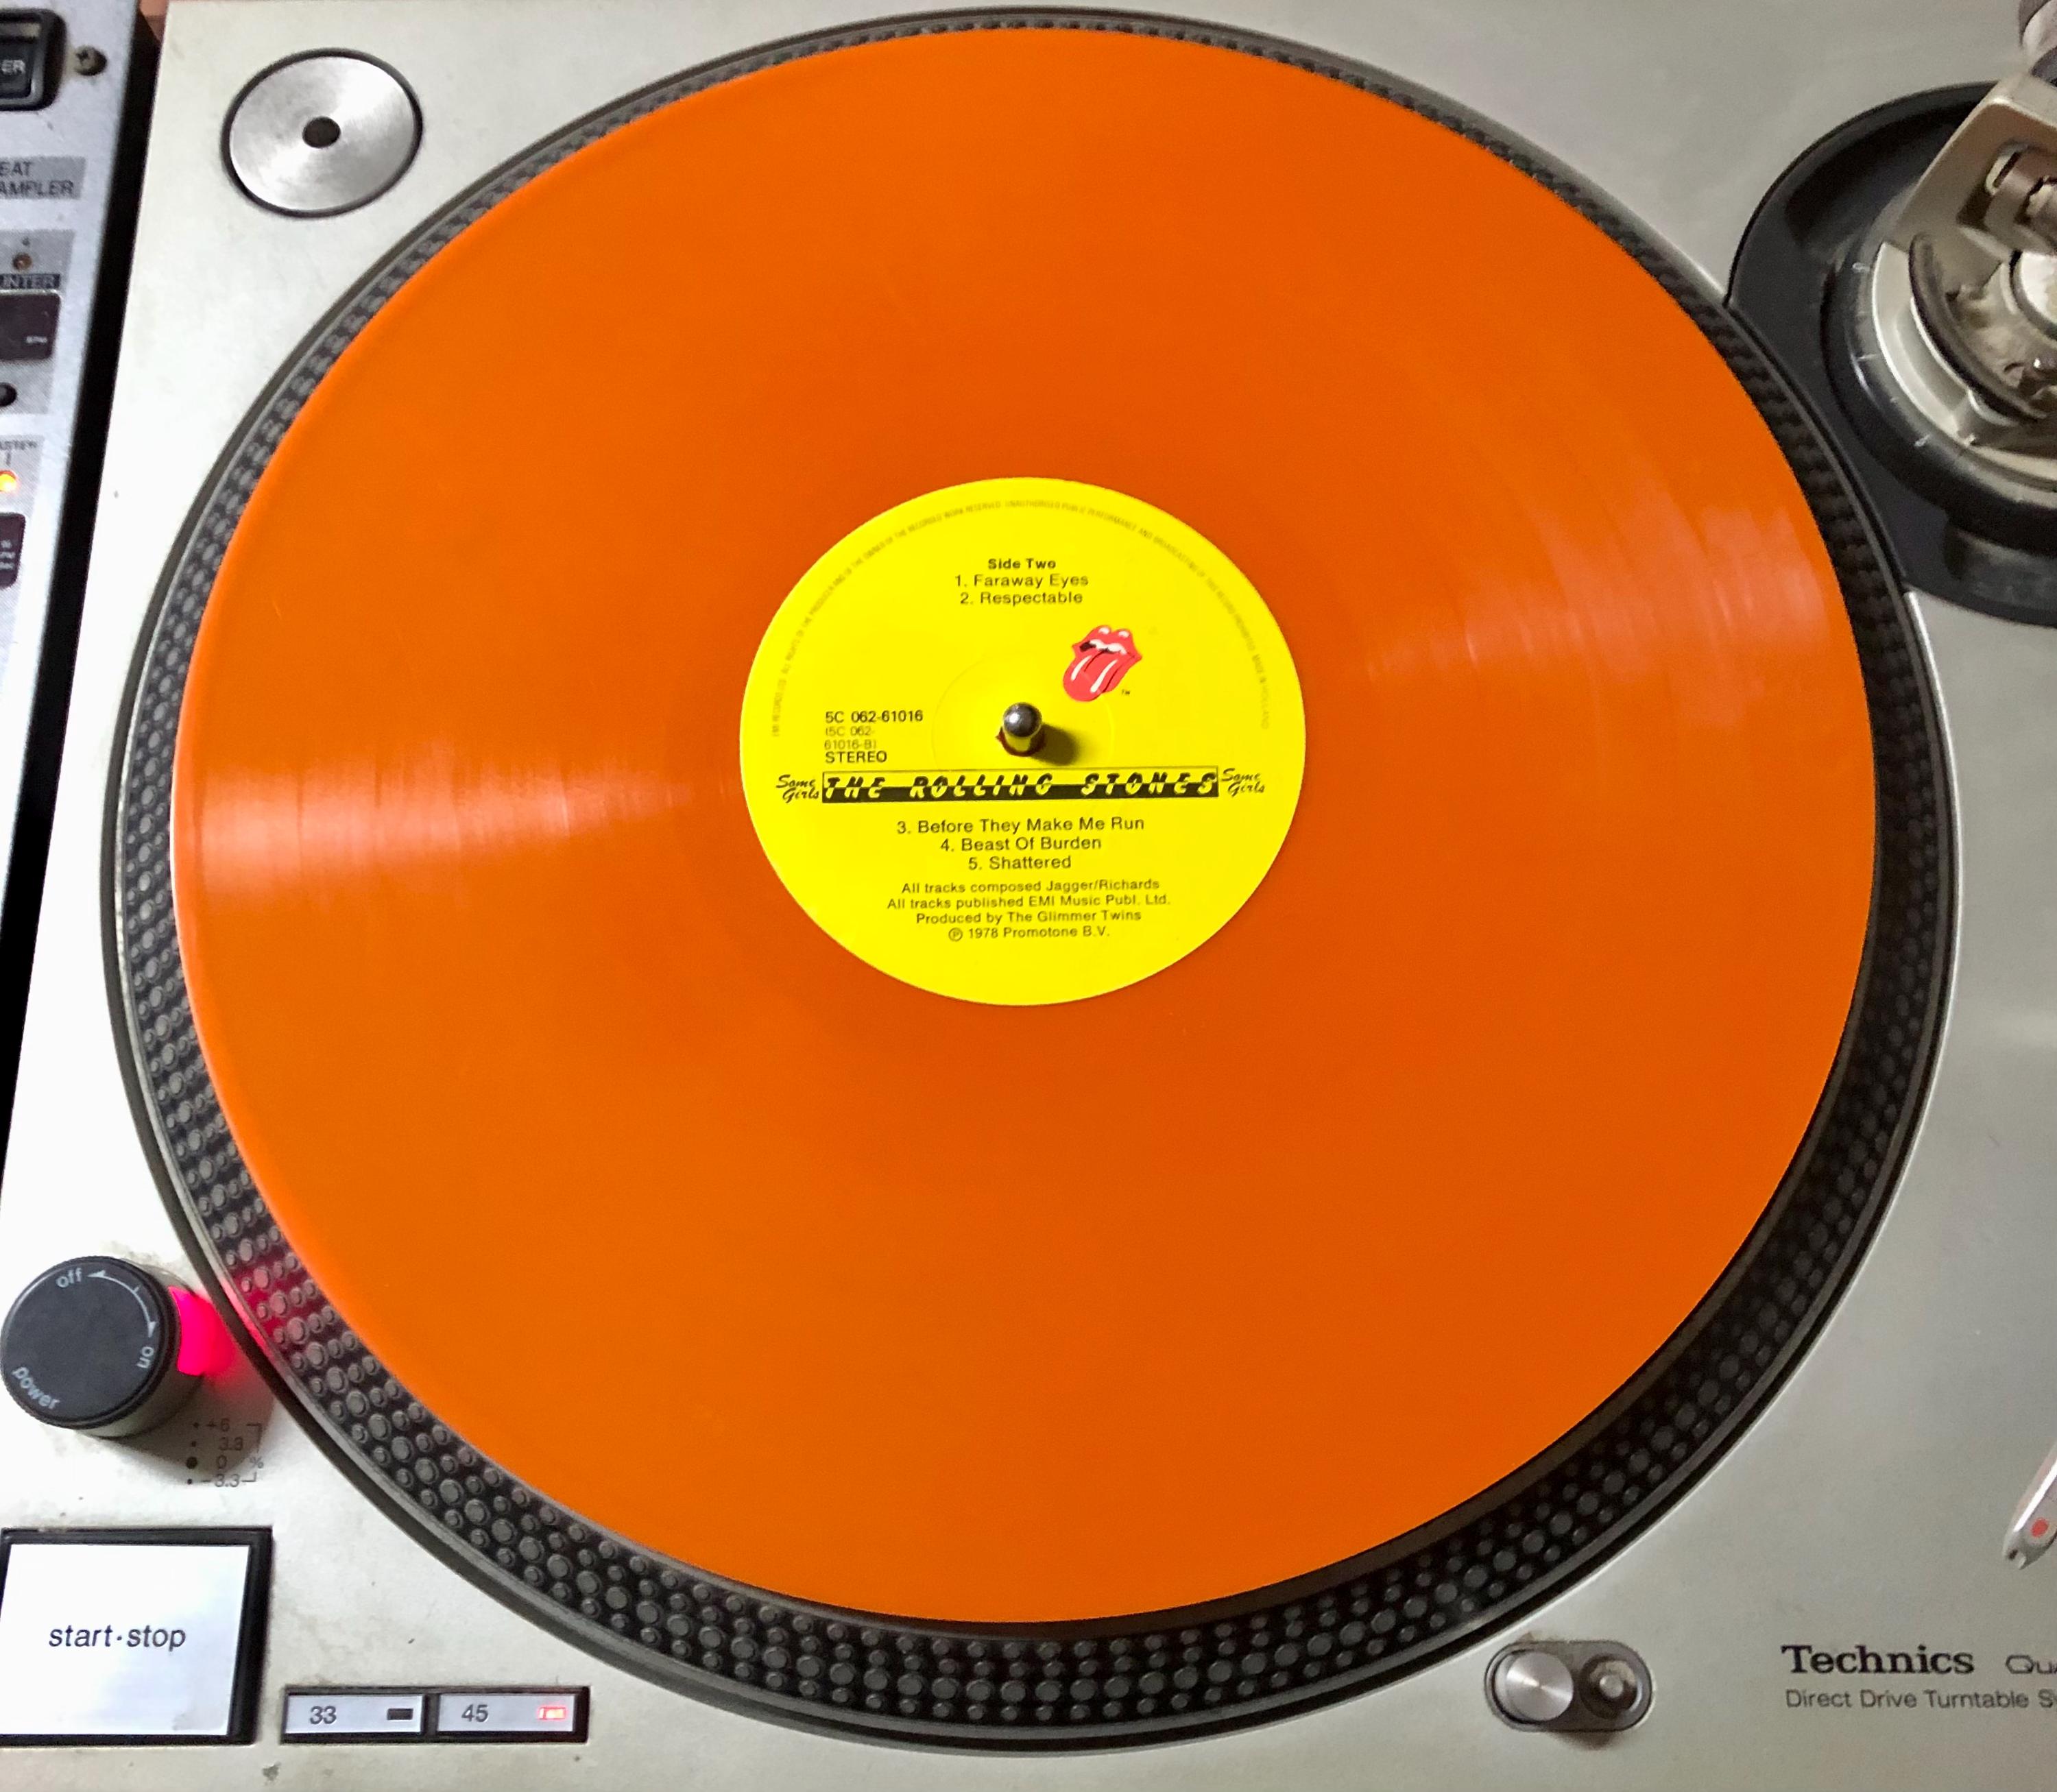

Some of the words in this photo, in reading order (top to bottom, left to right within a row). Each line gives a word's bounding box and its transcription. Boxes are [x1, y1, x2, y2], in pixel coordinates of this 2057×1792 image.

[988, 558, 1021, 570] Side
[1026, 558, 1056, 569] Two
[955, 574, 967, 587] 1.
[974, 574, 1043, 589] Faraway
[1050, 573, 1089, 589] Eyes
[960, 592, 973, 605] 2.
[981, 591, 1083, 607] Respectable
[826, 711, 844, 724] 5C
[851, 710, 923, 723] 062-61016
[825, 751, 888, 764] STEREO
[775, 774, 816, 789] Some
[1221, 767, 1262, 783] Some
[825, 776, 886, 799] THE
[909, 773, 1053, 799] ROLLING
[1081, 772, 1218, 796] STONES
[1228, 782, 1266, 797] Girls
[782, 788, 819, 803] Girls
[897, 821, 911, 834] 3.
[918, 820, 973, 834] Before
[979, 819, 1020, 835] They
[1027, 818, 1073, 832] Make
[1079, 817, 1105, 830] Me
[1111, 816, 1144, 830] Run
[940, 838, 954, 851] 4.
[961, 838, 1009, 851] Beast
[1015, 836, 1035, 851] Of
[1041, 836, 1101, 850] Burden
[969, 857, 982, 871] 5.
[989, 855, 1071, 870] Shattered
[902, 882, 919, 893] All
[924, 882, 965, 893] tracks
[970, 880, 1041, 895] composed
[1046, 878, 1159, 894] Jagger/Richards
[887, 899, 905, 909] All
[911, 897, 951, 909] tracks
[956, 896, 1023, 912] published
[1029, 895, 1055, 907] EMI
[1060, 893, 1100, 906] Music
[1105, 894, 1140, 906] Publ.
[1145, 894, 1170, 905] Ltd.
[917, 912, 981, 924] Produced
[986, 912, 1002, 925] by
[1007, 911, 1033, 923] The
[1037, 910, 1097, 922] Glimmer
[1100, 910, 1141, 921] Twins
[969, 928, 998, 939] 1978
[1003, 927, 1078, 938] Promotone
[1083, 925, 1109, 937] B.V.
[56, 1267, 82, 1288] off
[138, 1345, 155, 1369] on
[12, 1366, 60, 1410] power
[1780, 1644, 1975, 1675] Technics
[1786, 1688, 1851, 1708] Direct
[1860, 1688, 1917, 1708] Drive
[1923, 1688, 2029, 1708] Turntable
[2038, 1688, 2057, 1709] S
[309, 1706, 337, 1725] 33
[461, 1704, 490, 1723] 45
